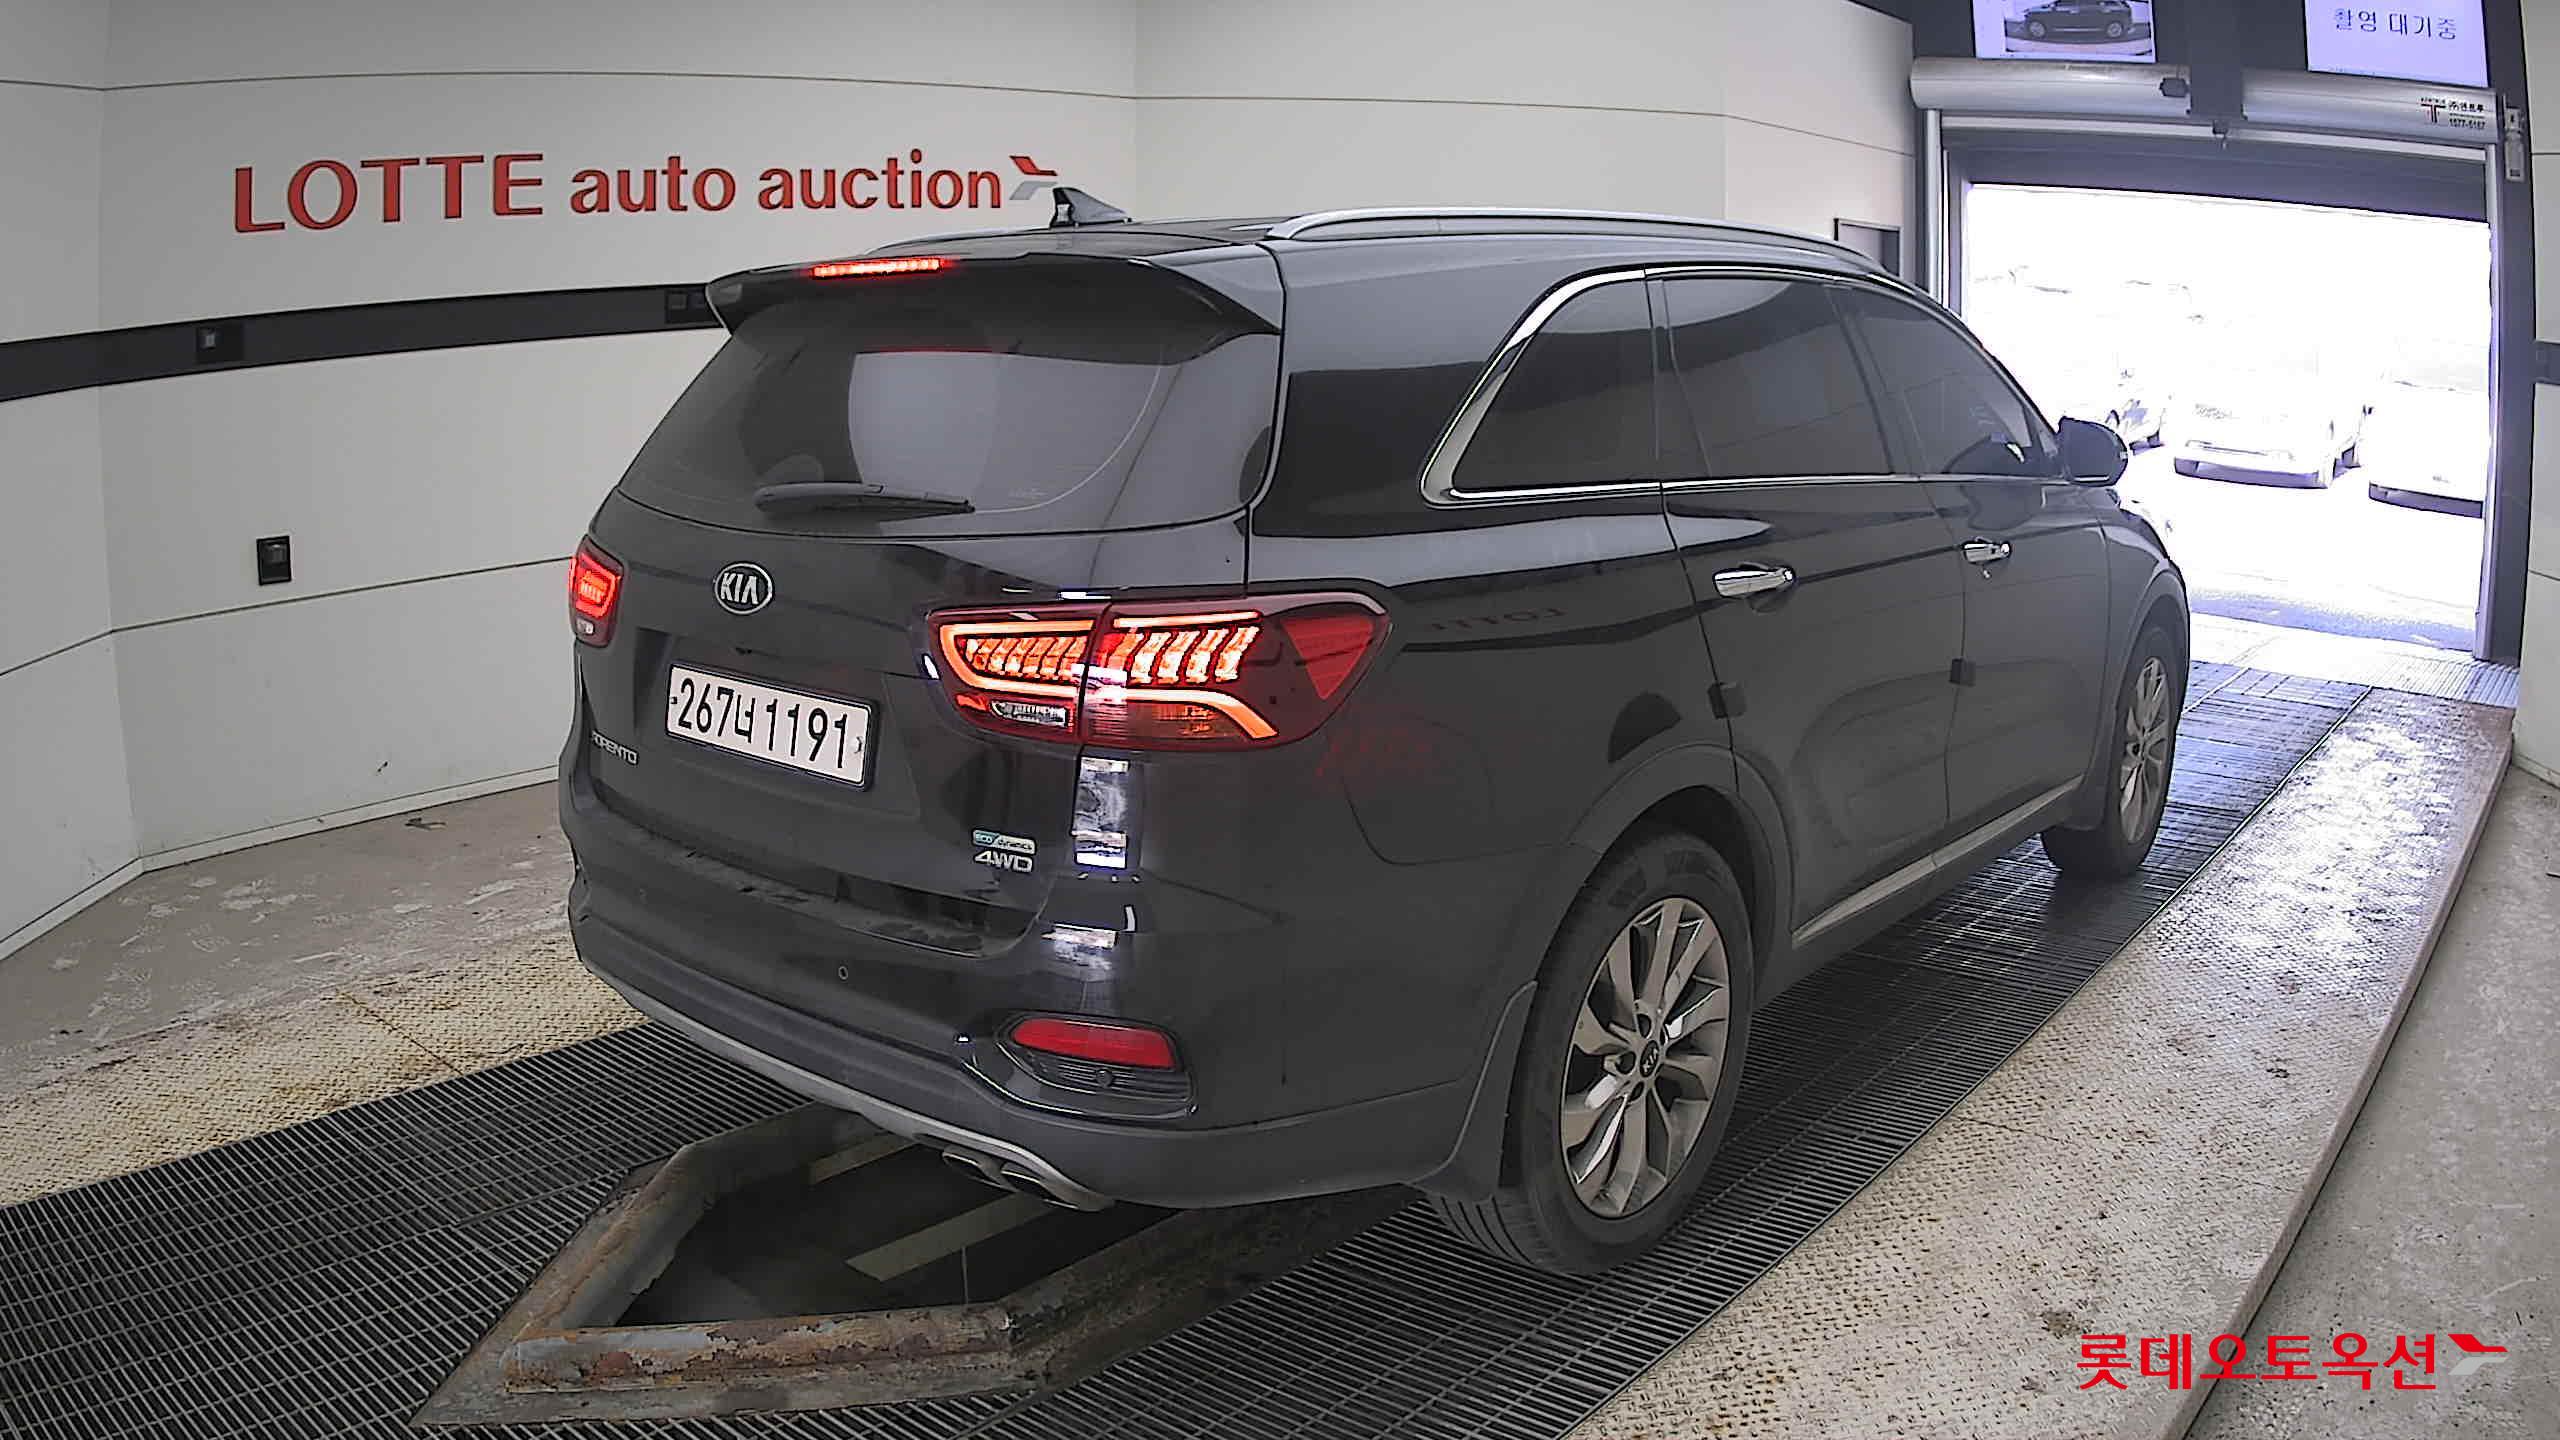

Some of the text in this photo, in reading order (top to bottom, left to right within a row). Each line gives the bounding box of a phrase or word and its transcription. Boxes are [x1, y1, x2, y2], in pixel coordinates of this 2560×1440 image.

[234, 146, 1004, 233] LOTTE auto auction
[720, 571, 760, 605] KIA
[677, 677, 848, 769] 267너1191
[974, 850, 1034, 874] 4WD
